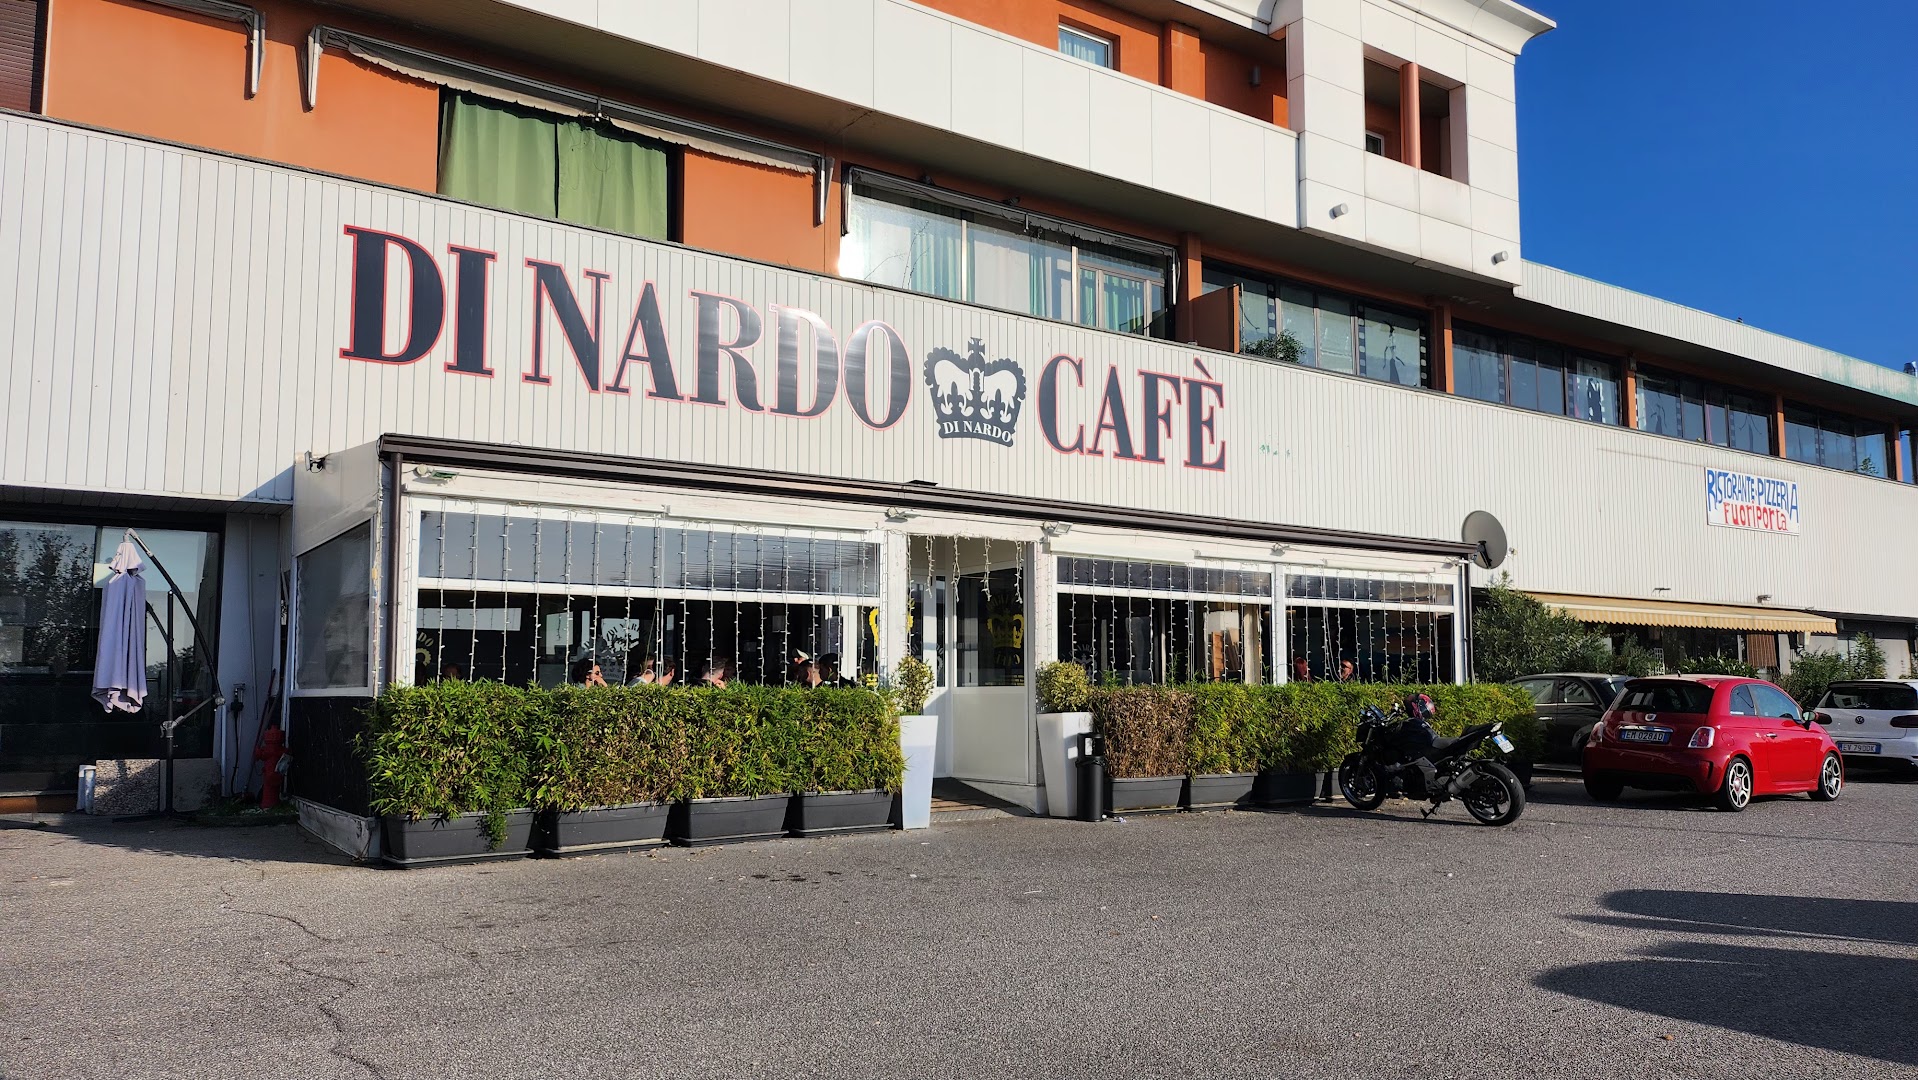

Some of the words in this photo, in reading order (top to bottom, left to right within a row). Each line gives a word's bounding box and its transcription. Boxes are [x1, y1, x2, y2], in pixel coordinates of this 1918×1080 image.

[339, 224, 496, 378] DI
[521, 258, 912, 431] NARDO
[1036, 353, 1226, 472] CAFÈ
[943, 421, 960, 434] DI
[963, 421, 1011, 442] NARDO
